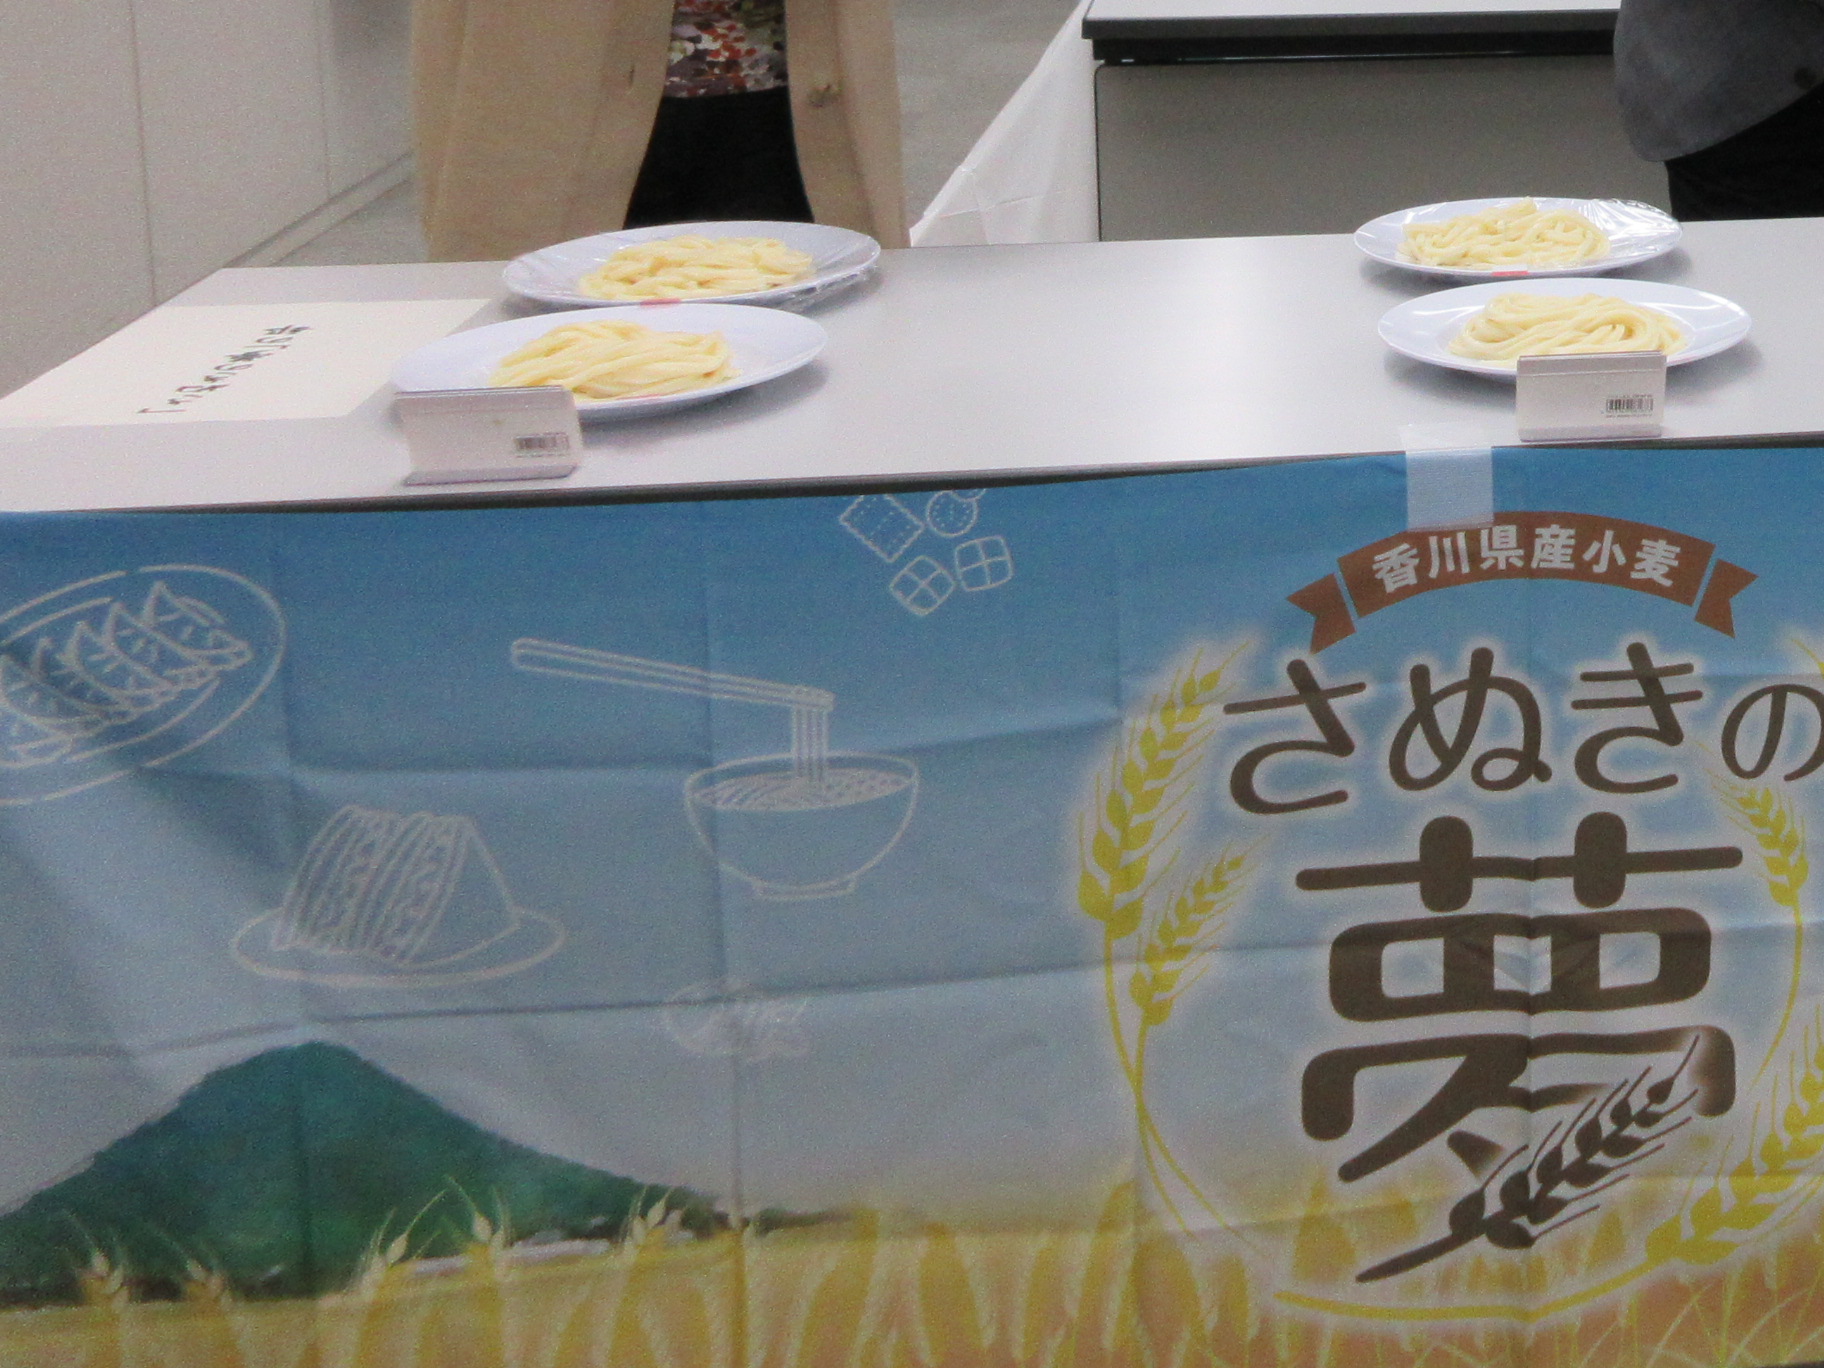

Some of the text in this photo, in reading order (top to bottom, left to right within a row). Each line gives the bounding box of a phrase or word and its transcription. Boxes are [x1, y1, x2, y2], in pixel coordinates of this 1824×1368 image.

[1370, 523, 1682, 595] 香川県産小麦
[1294, 810, 1744, 1284] 夢
